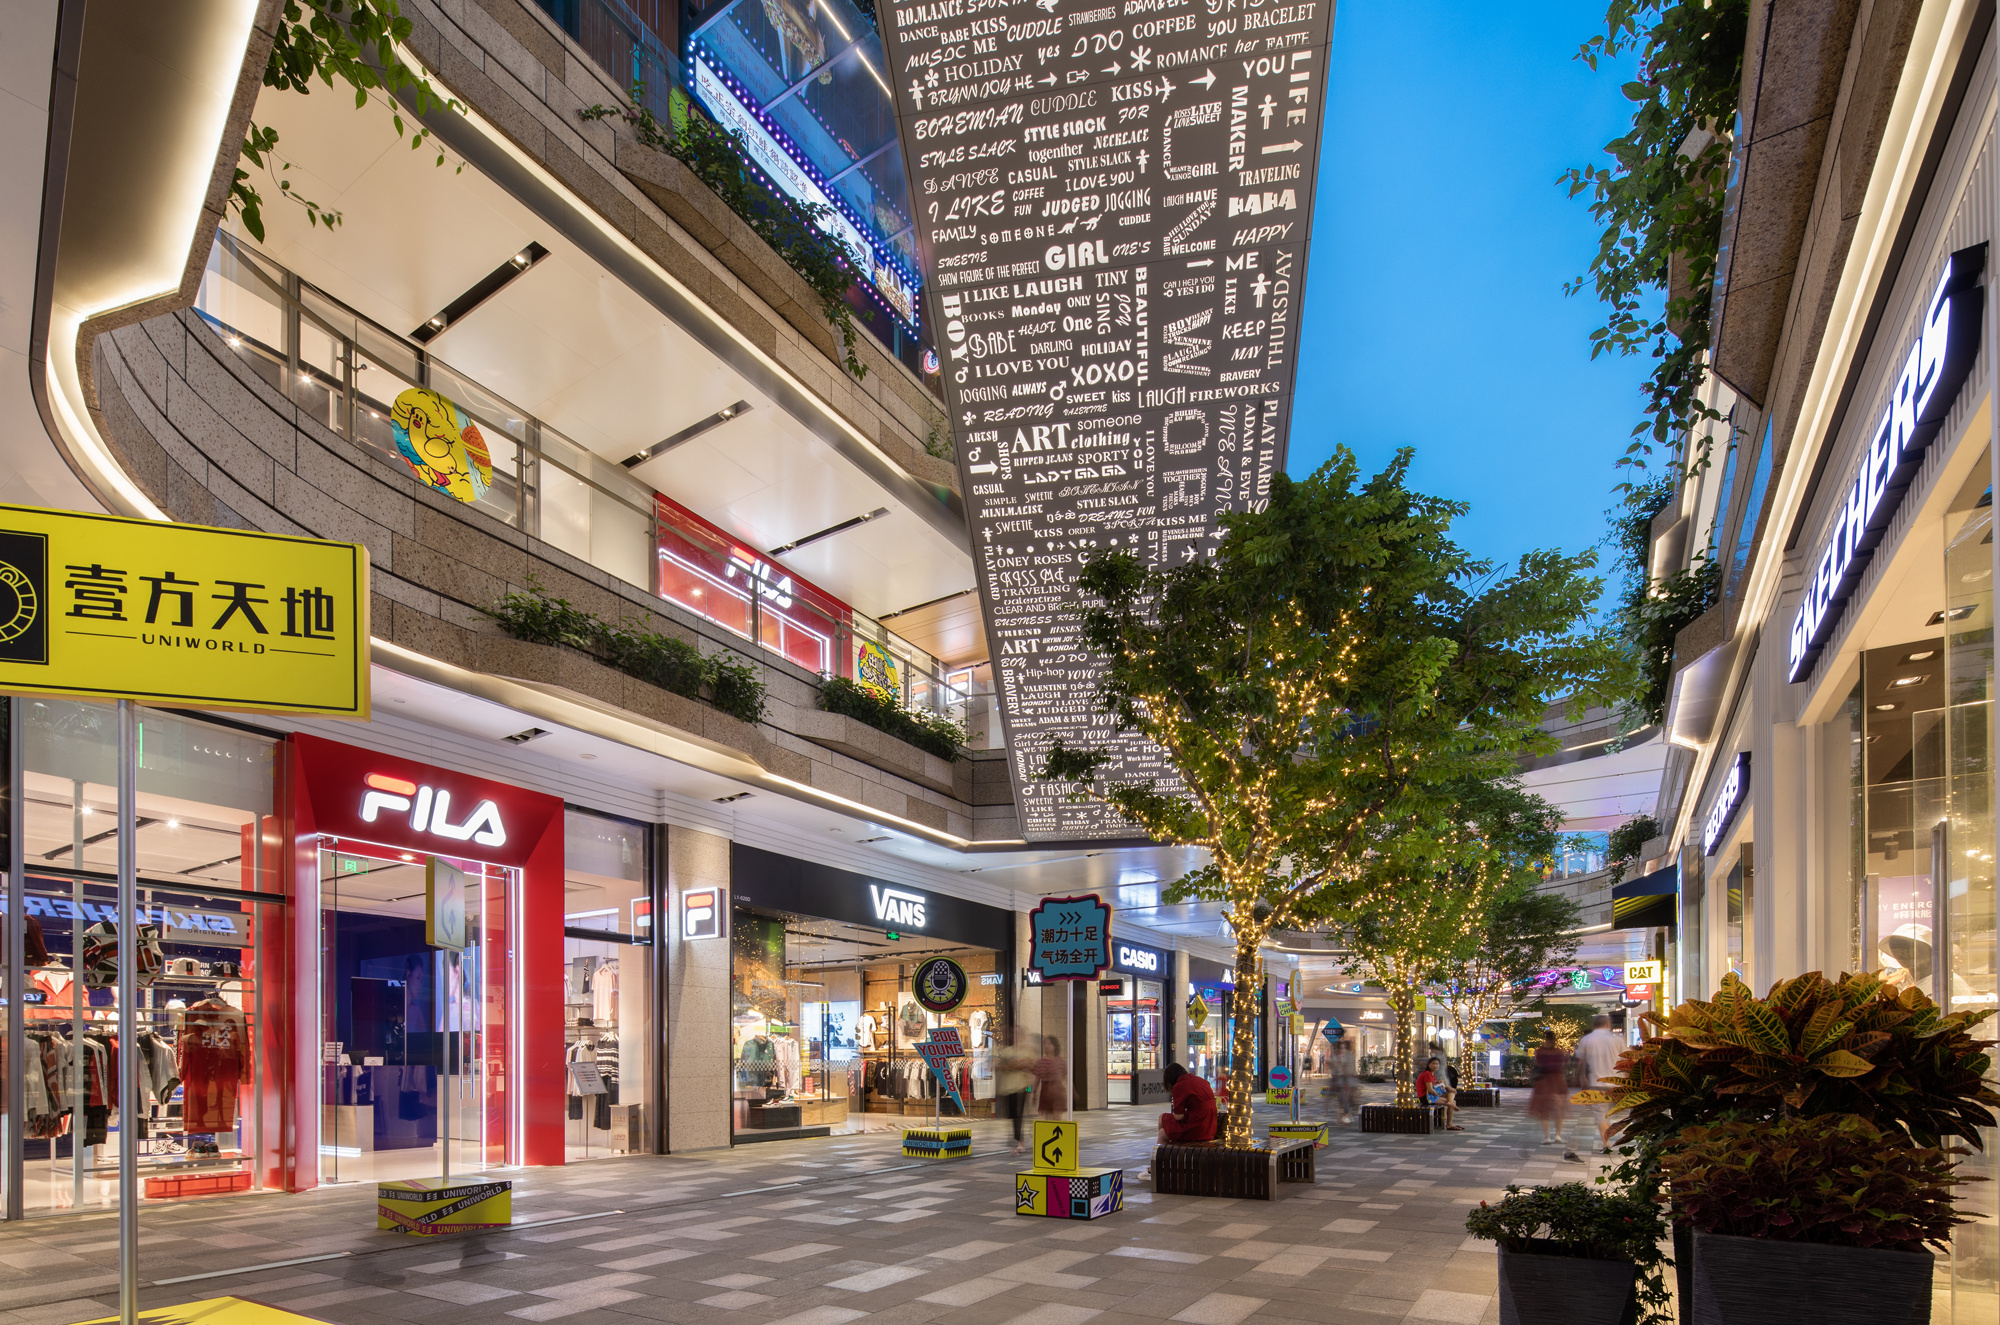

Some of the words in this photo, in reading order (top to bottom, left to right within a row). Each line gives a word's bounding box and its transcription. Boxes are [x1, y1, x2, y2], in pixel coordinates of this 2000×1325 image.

[1069, 6, 1116, 26] STRAWBERRIES
[1132, 14, 1196, 40] COFFEE
[1243, 3, 1316, 31] BRACELET
[900, 26, 939, 43] DANCE
[941, 28, 970, 45] BABE
[970, 16, 1008, 36] KISS
[1007, 17, 1063, 42] CUDDLE
[905, 45, 966, 72] MUSIC
[973, 37, 998, 54] ME
[1037, 45, 1060, 65] yes
[1090, 30, 1124, 54] DO
[1156, 43, 1228, 70] ROMANCE
[1234, 39, 1260, 54] her
[944, 54, 1023, 82] HOLIDAY
[1242, 54, 1285, 79] YOU
[928, 83, 978, 106] BRYNN
[980, 78, 1011, 99] JOY
[1015, 74, 1035, 91] HE
[1111, 81, 1153, 102] KISS
[1030, 90, 1097, 116] CUDDLE
[1118, 104, 1150, 124] FOR
[914, 103, 1025, 140] BOHEMIAN
[1024, 124, 1060, 143] STYLE
[1063, 116, 1107, 137] SLACK
[1228, 85, 1249, 173] MAKER
[1093, 128, 1150, 150] NECKLACE
[1163, 127, 1172, 168] DANCE
[920, 147, 965, 169] STYLE
[968, 139, 1017, 160] SLACK
[1028, 143, 1083, 164] togenther
[1068, 155, 1098, 172] STYLE
[1100, 150, 1132, 168] SLACK
[1008, 166, 1058, 185] CASUAL
[1192, 162, 1219, 178] GIRL
[1239, 163, 1301, 187] TRAVELING
[923, 168, 999, 195] DANCE
[1073, 173, 1108, 191] LOVE
[1012, 186, 1045, 202] COFFEE
[1104, 187, 1151, 212] JOGGING
[1185, 188, 1218, 204] HAVE
[1228, 188, 1297, 218] HAHA
[944, 190, 1005, 221] LIKE
[1014, 204, 1032, 217] FUN
[1042, 194, 1101, 218] JUDGED
[1119, 213, 1151, 227] CUDDLE
[931, 224, 977, 244] FAMILY
[1232, 222, 1294, 246] HAPPY
[1045, 240, 1109, 271] GIRL
[1112, 241, 1151, 257] ONE'S
[1171, 240, 1216, 255] WELCOME
[938, 251, 988, 269] SWEETIE
[1225, 252, 1260, 272] ME
[938, 272, 958, 287] SHOW
[959, 269, 984, 284] FIGURE
[1011, 261, 1040, 277] PERFECT
[1095, 270, 1129, 288] TINY
[972, 285, 1010, 302] LIKE
[1013, 276, 1083, 299] LAUGH
[1225, 278, 1237, 315] LIKE
[961, 309, 1005, 323] BOOKS
[1011, 302, 1061, 318] Monday
[1067, 295, 1091, 308] ONLY
[1096, 292, 1111, 335] SING
[1267, 249, 1293, 370] THURSDAY
[942, 292, 970, 363] BOY
[1063, 315, 1093, 332] One
[1135, 267, 1149, 387] BEAUTIFUL
[1222, 319, 1266, 340] KEEP
[968, 329, 1017, 359] BABE
[1030, 339, 1073, 355] DARLING
[1081, 339, 1132, 357] HOLIDAY
[1231, 345, 1264, 361] MAY
[985, 359, 1034, 376] LOVE
[1036, 356, 1070, 370] YOU
[1071, 360, 1135, 387] XOXO
[1220, 368, 1262, 383] BRAVERY
[959, 384, 1008, 405] JOGGING
[1012, 381, 1047, 397] ALWAYS
[1066, 392, 1106, 405] SWEET
[1112, 390, 1131, 404] kiss
[1138, 386, 1186, 409] LAUGH
[1189, 381, 1280, 402] FIREWORKS
[983, 403, 1055, 423] READING
[1062, 404, 1108, 417] VALENTINE
[1077, 414, 1142, 431] someone
[1242, 403, 1256, 452] ADAM
[1261, 400, 1279, 446] PLAY
[966, 430, 998, 444] ARTSY
[1011, 422, 1071, 454] ART
[1071, 431, 1131, 449] clothing
[997, 441, 1012, 480] SHOPS
[1014, 455, 1044, 467] RIPPED
[1045, 452, 1074, 466] JEANS
[1077, 449, 1130, 465] SPORTY
[1146, 438, 1155, 473] LOVE
[1257, 450, 1274, 496] HARD
[1789, 257, 1951, 683] SKECHERS
[973, 483, 1005, 496] CASUAL
[1239, 470, 1251, 501] EVE
[984, 496, 1017, 506] SIMPLE
[1024, 491, 1053, 504] SWEETIE
[1076, 497, 1106, 510] STYLE
[1108, 494, 1139, 507] SLACK
[1078, 509, 1134, 523] DREAMS
[1156, 516, 1186, 527] KISS
[1188, 514, 1208, 525] ME
[995, 519, 1034, 535] SWEETIE
[1034, 527, 1064, 539] KISS
[1068, 526, 1096, 536] ORDER
[984, 545, 997, 571] PLAY
[1034, 553, 1072, 565] ROSES
[725, 547, 794, 609] FILA
[1002, 584, 1070, 597] TRAVELING
[65, 564, 336, 640] 壹方天地
[993, 605, 1024, 616] CLEAR
[1025, 603, 1046, 613] AND
[1082, 599, 1106, 608] PUPIL
[994, 615, 1053, 627] BUSINESS
[142, 633, 265, 655] UNIWORLD
[997, 628, 1042, 638] FRIEND
[1000, 638, 1040, 655] ART
[1026, 667, 1065, 681] Hip-hop
[1001, 669, 1020, 716] BRAVERY
[1023, 683, 1068, 693] VALENTINE
[360, 772, 507, 847] FILA
[870, 885, 925, 927] VANS
[188, 929, 231, 937] ORIGINALE
[1041, 926, 1098, 944] 潮力十足
[1041, 948, 1098, 965] 气场全开
[1120, 947, 1157, 970] CASIO
[1629, 966, 1653, 979] CAT
[931, 1029, 960, 1043] 2019
[917, 1043, 964, 1056] YOUNG
[931, 1056, 947, 1069] 07
[943, 1069, 952, 1081] 2
[946, 1081, 957, 1092] 8
[397, 1191, 423, 1201] UNIWORLD
[457, 1186, 502, 1210] UNIWORLD
[394, 1214, 420, 1231] UNIWORLD
